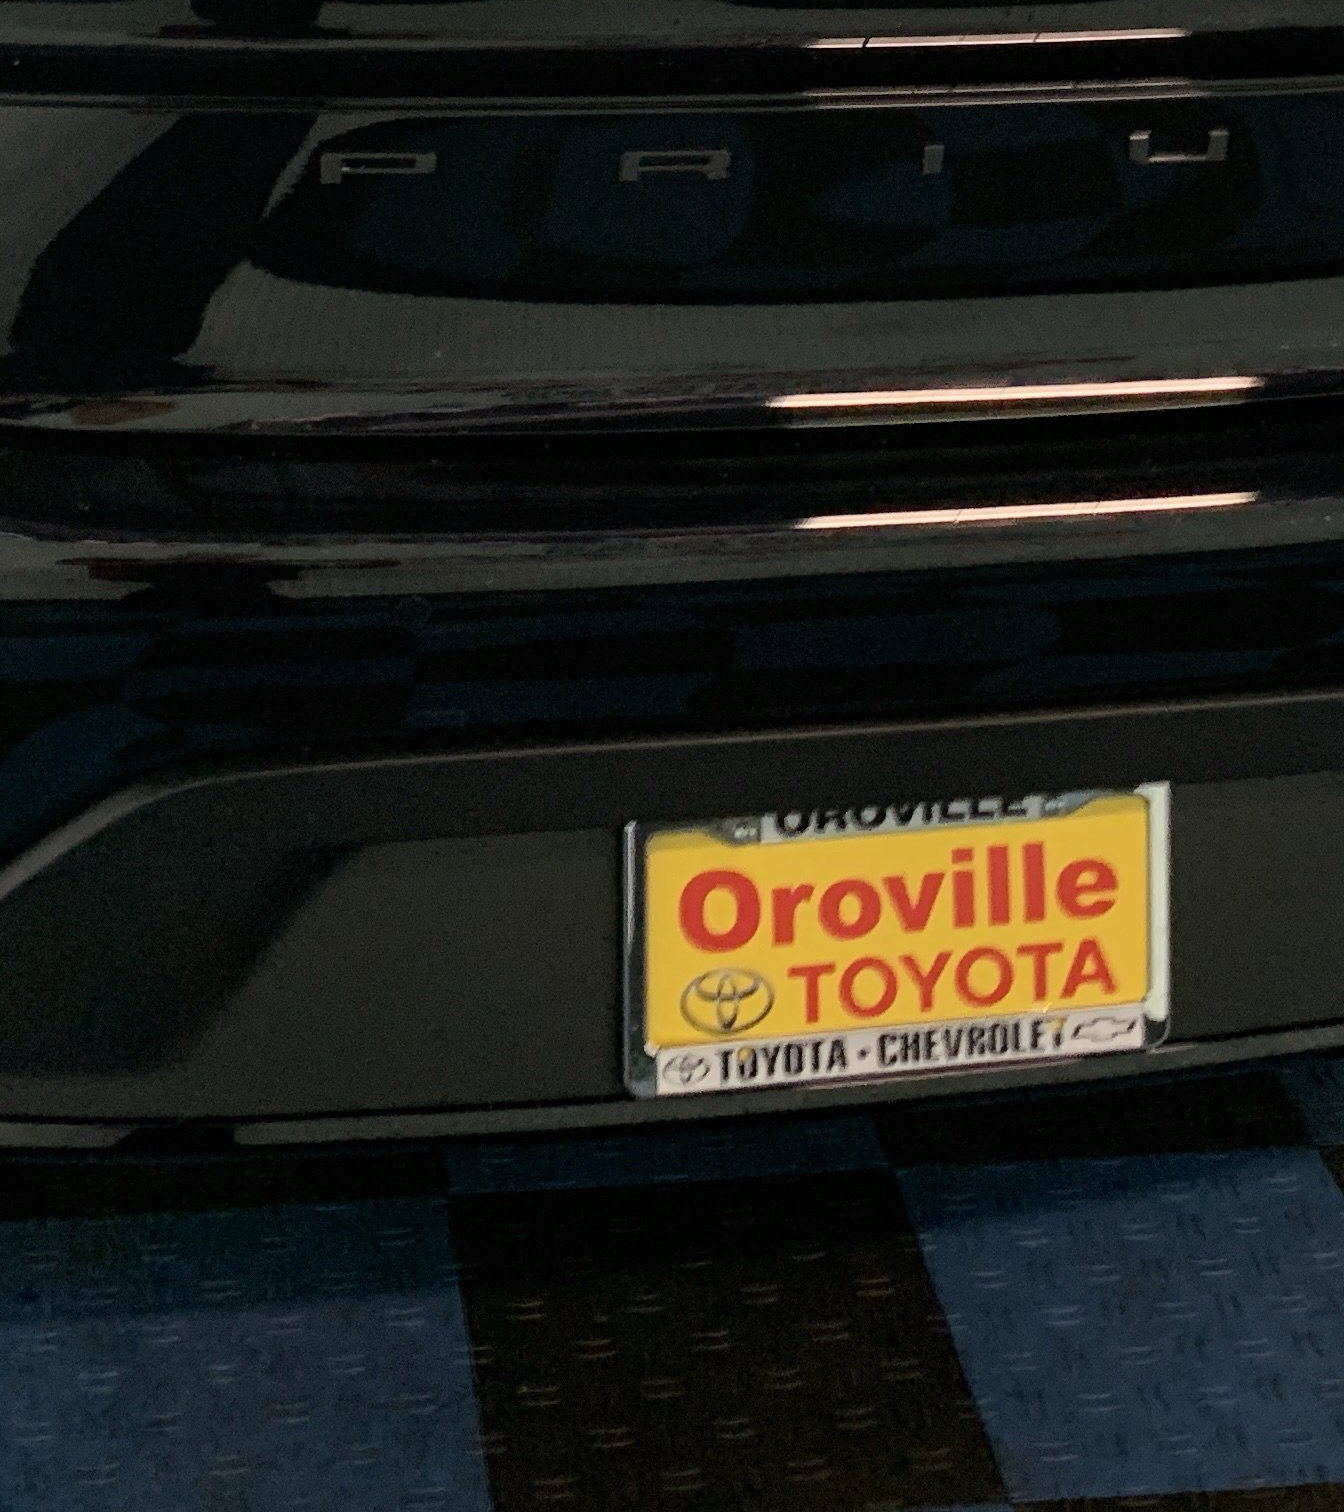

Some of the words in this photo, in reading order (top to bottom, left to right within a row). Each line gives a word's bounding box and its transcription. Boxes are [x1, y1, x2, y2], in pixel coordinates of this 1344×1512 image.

[678, 841, 1119, 954] Oroville
[787, 937, 1119, 1024] TOYOTA
[719, 1038, 849, 1082] TOYOTA
[877, 1015, 1066, 1068] CHEVROLET
